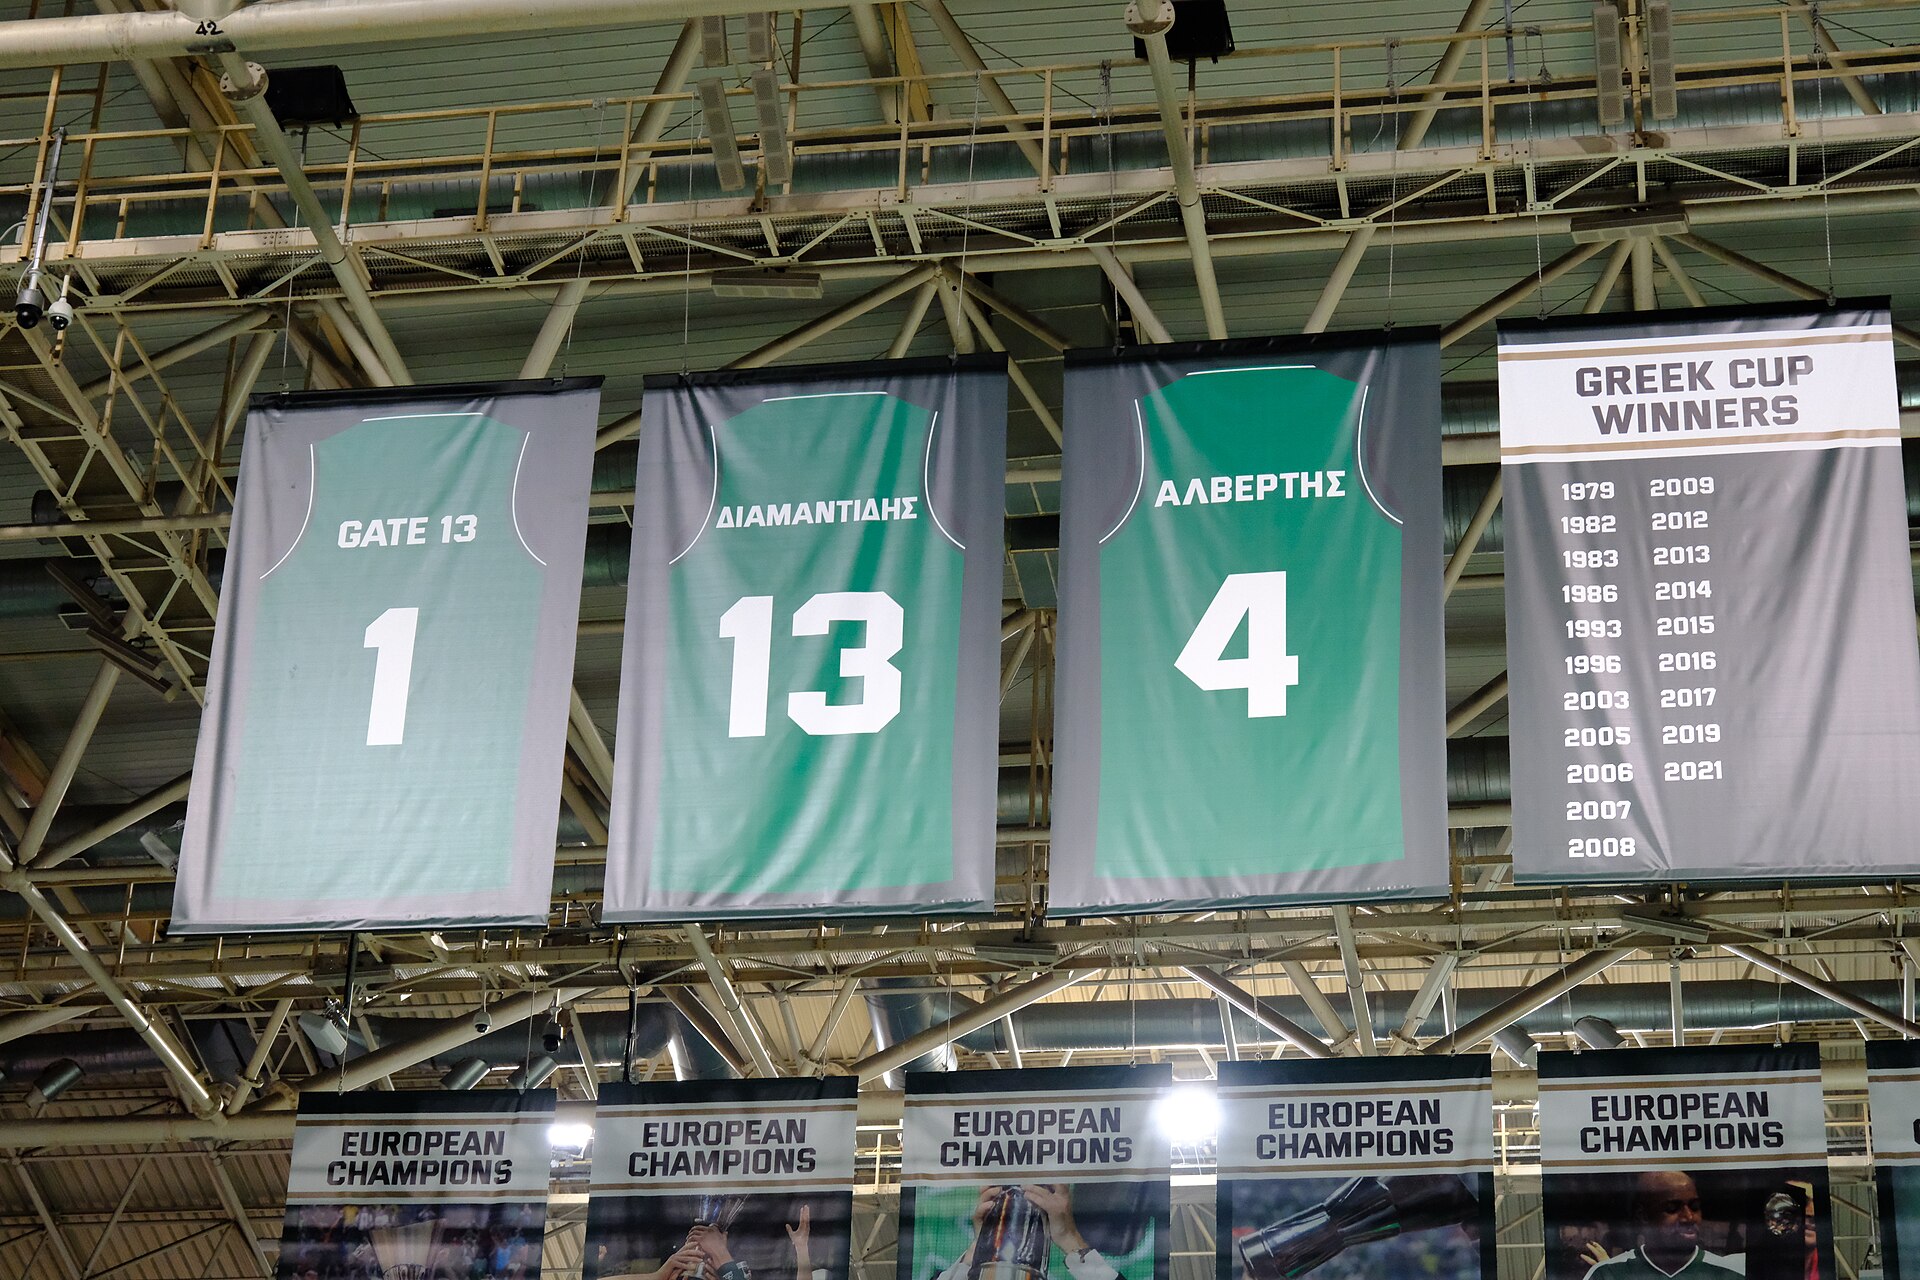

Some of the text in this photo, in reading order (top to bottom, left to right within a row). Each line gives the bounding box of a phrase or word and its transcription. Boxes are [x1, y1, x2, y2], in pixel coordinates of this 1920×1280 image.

[196, 20, 223, 35] 42
[1576, 355, 1813, 397] GREEK CUP
[1592, 395, 1798, 435] WINNERS
[1154, 471, 1345, 507] ΑΛΒΕΡΤΗΣ
[1562, 482, 1614, 500] 1979
[1650, 477, 1714, 496] 2009
[716, 497, 917, 528] ΔΙΑΜΑΝΤΙΔΗΣ
[1652, 511, 1708, 530] 2012
[338, 515, 477, 548] GATE 13
[1561, 515, 1616, 533] 1982
[1563, 550, 1618, 568] 1983
[1654, 546, 1710, 565] 2013
[1563, 585, 1617, 603] 1986
[1655, 581, 1711, 600] 2014
[1566, 620, 1621, 638] 1993
[1657, 616, 1714, 635] 2015
[1174, 571, 1298, 718] 4
[719, 591, 903, 738] 13
[1565, 655, 1621, 674] 1996
[1659, 652, 1716, 671] 2016
[364, 608, 418, 745] 1
[1564, 691, 1629, 710] 2003
[1661, 688, 1716, 707] 2017
[1565, 727, 1631, 746] 2005
[1663, 724, 1720, 744] 2019
[1567, 763, 1633, 783] 2006
[1665, 761, 1722, 781] 2021
[1567, 801, 1631, 820] 2007
[1569, 837, 1635, 857] 2008
[1269, 1099, 1440, 1129] EUROPEAN
[1592, 1091, 1768, 1122] EUROPEAN
[954, 1107, 1120, 1137] EUROPEAN
[643, 1119, 806, 1147] EUROPEAN
[1581, 1122, 1783, 1153] CHAMPIONS
[342, 1131, 504, 1156] EUROPEAN
[940, 1138, 1132, 1166] CHAMPIONS
[1257, 1129, 1453, 1159] CHAMPIONS
[327, 1160, 512, 1185] CHAMPIONS
[629, 1148, 816, 1177] CHAMPIONS
